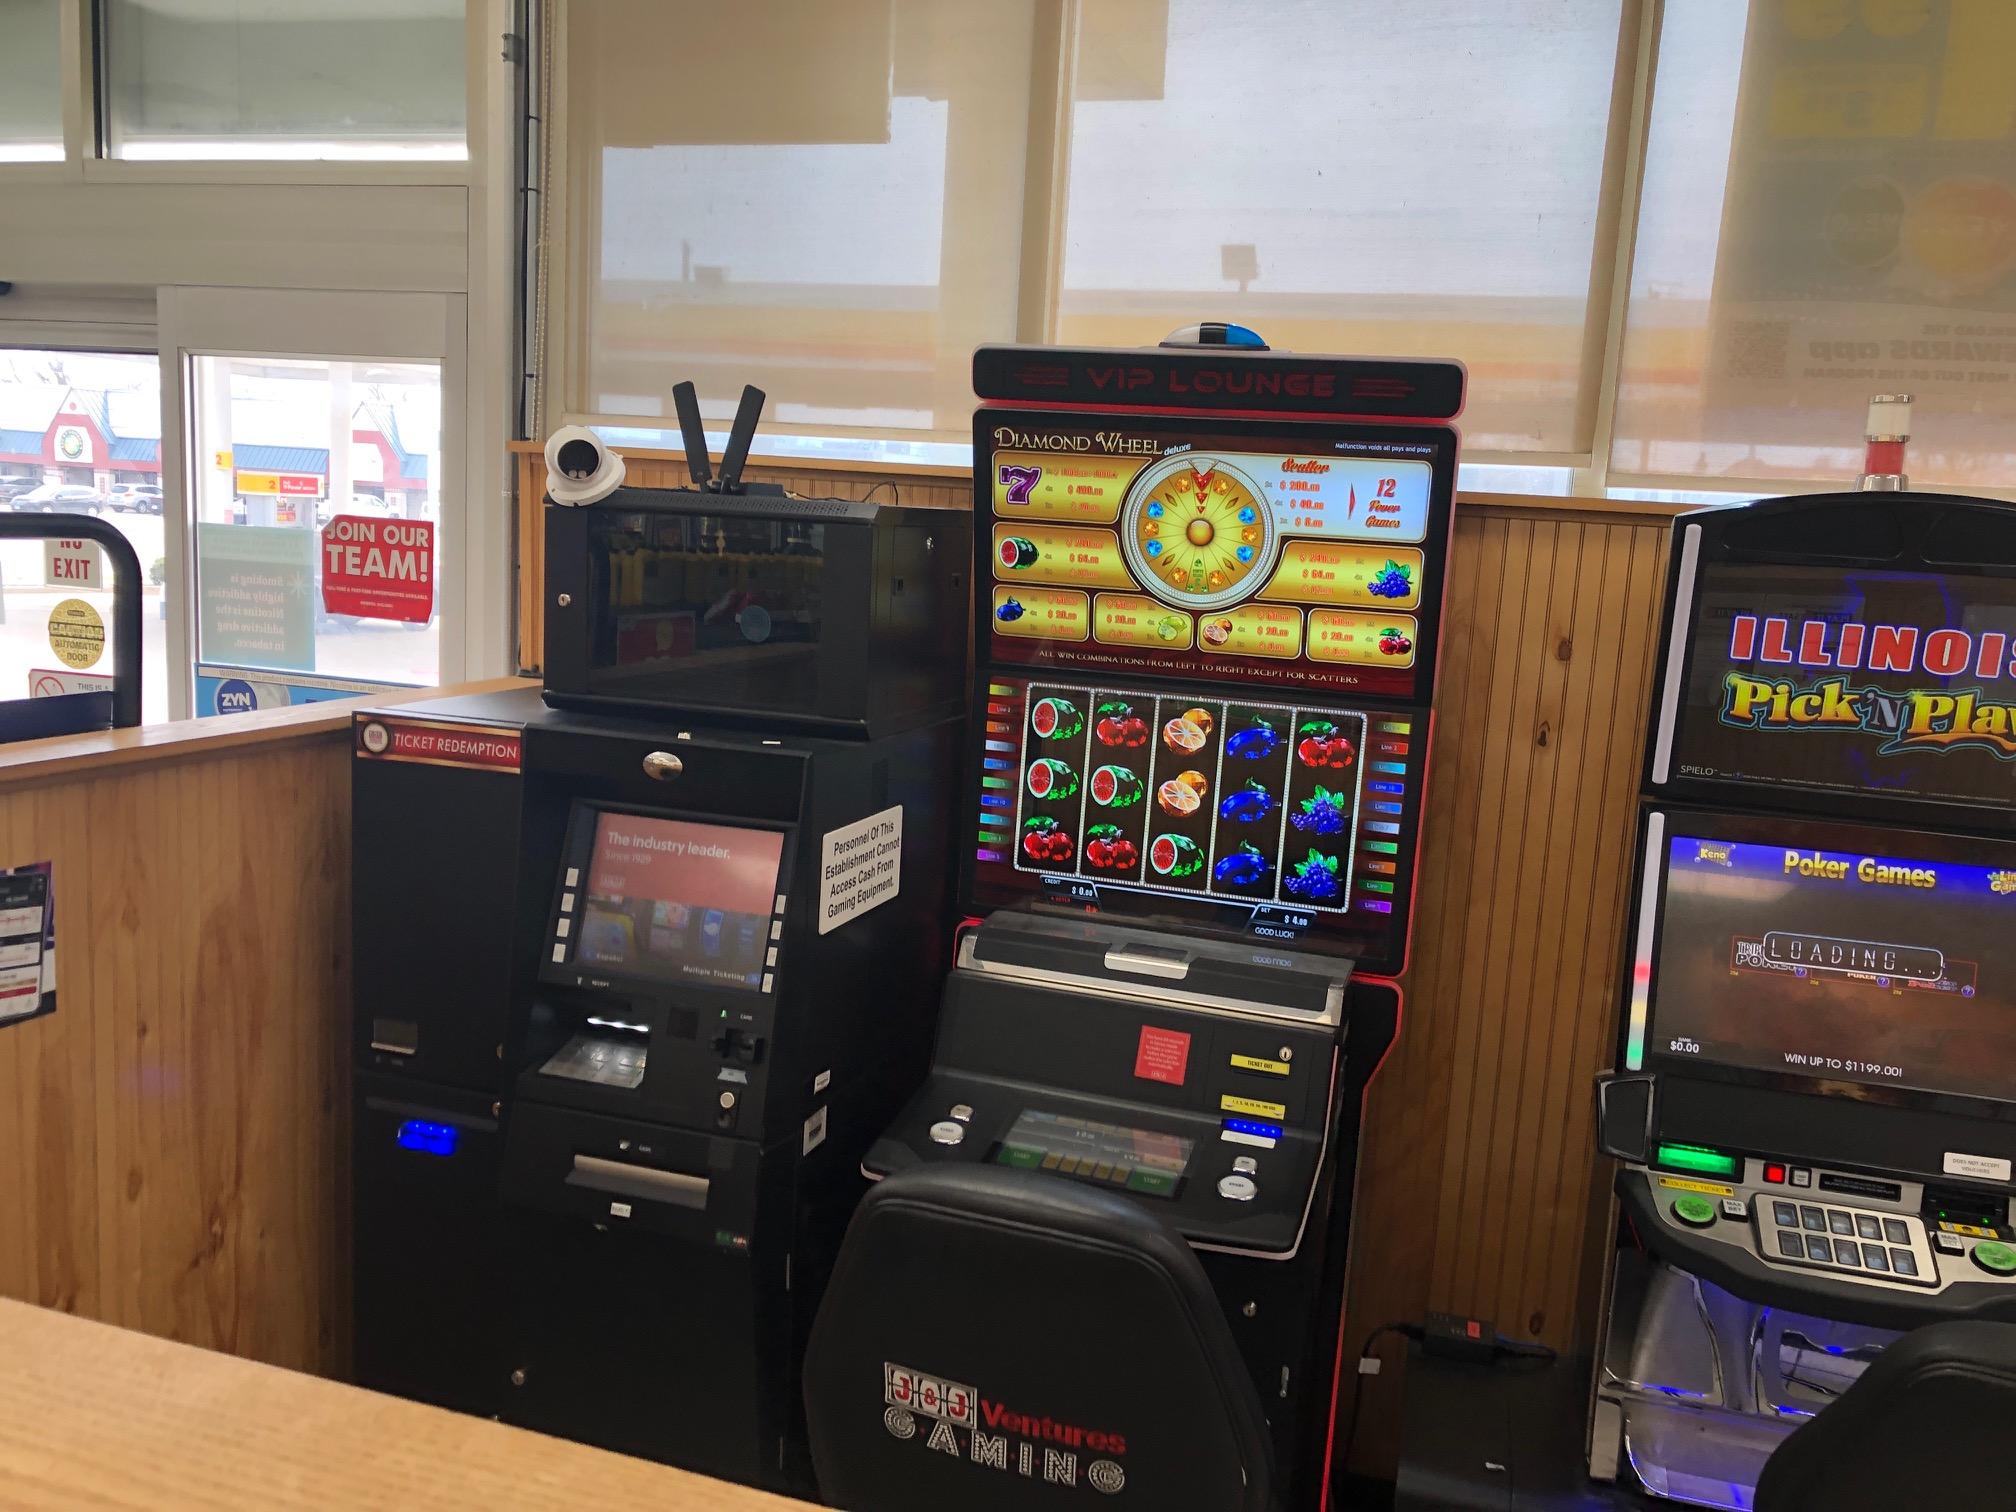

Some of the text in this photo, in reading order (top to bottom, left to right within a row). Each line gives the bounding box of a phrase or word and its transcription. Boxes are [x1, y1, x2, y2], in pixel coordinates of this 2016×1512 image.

[1087, 367, 1337, 397] VIP LOUNGE
[994, 427, 1191, 455] DIAMOND WHEEL deluxe
[1335, 443, 1367, 451] Malfunction
[1416, 446, 1431, 454] plays
[1281, 457, 1330, 474] Scatter
[1377, 479, 1397, 498] 12
[1369, 499, 1401, 512] Fever
[327, 521, 429, 547] JOIN OUR
[1366, 515, 1400, 528] Games
[53, 557, 90, 580] EXIT
[325, 544, 428, 583] TEAM!
[1730, 616, 2016, 679] ILLINOI
[1039, 650, 1359, 685] ALL WIN COMBINATIONS FROM LEFT TO RIGHT EXCEPT FOR SCATTERS
[78, 683, 94, 691] THIS
[222, 692, 249, 706] ZYN
[1729, 675, 1860, 722] Pick
[394, 733, 435, 750] TICKET
[437, 739, 518, 759] REDEMPTION
[608, 831, 731, 860] The industry leader.
[834, 821, 894, 856] Personnel Of This
[825, 837, 900, 880] Establishment Cannot
[1701, 848, 1725, 859] Keno
[830, 859, 894, 898] Access Cash From
[1784, 850, 1936, 888] Poker Games
[1079, 886, 1093, 897] 0.00
[827, 896, 856, 918] Gaming
[1255, 926, 1295, 939] GOOD LUCK!
[1772, 939, 1936, 975] LOADING...
[713, 969, 745, 982] Ticketing
[1670, 1041, 1699, 1054] $0.00
[1248, 1060, 1263, 1068] TICKET
[1784, 1052, 1902, 1078] WIN UP TO $1199.00!
[981, 1399, 1126, 1455] Ventures
